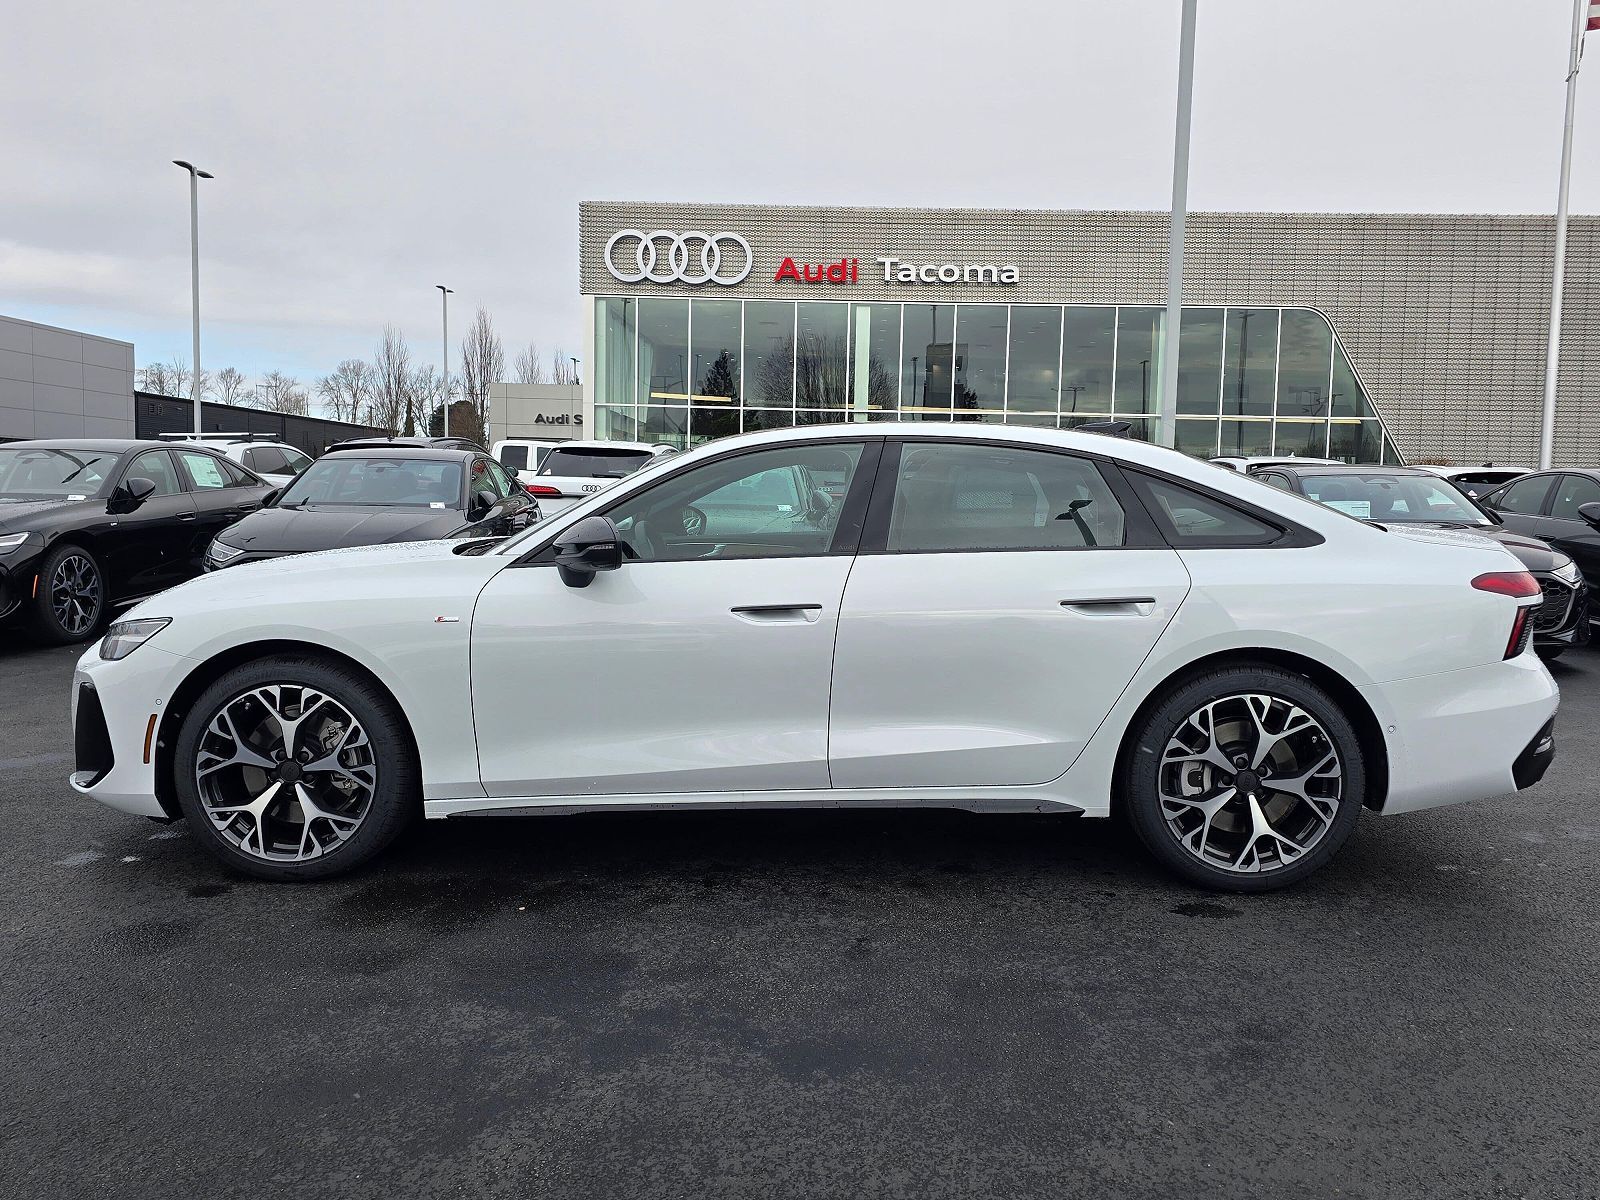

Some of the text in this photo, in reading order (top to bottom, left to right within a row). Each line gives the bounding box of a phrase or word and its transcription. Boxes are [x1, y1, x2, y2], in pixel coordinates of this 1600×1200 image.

[774, 257, 1021, 284] Audi Tacoma
[534, 413, 569, 424] Audi
